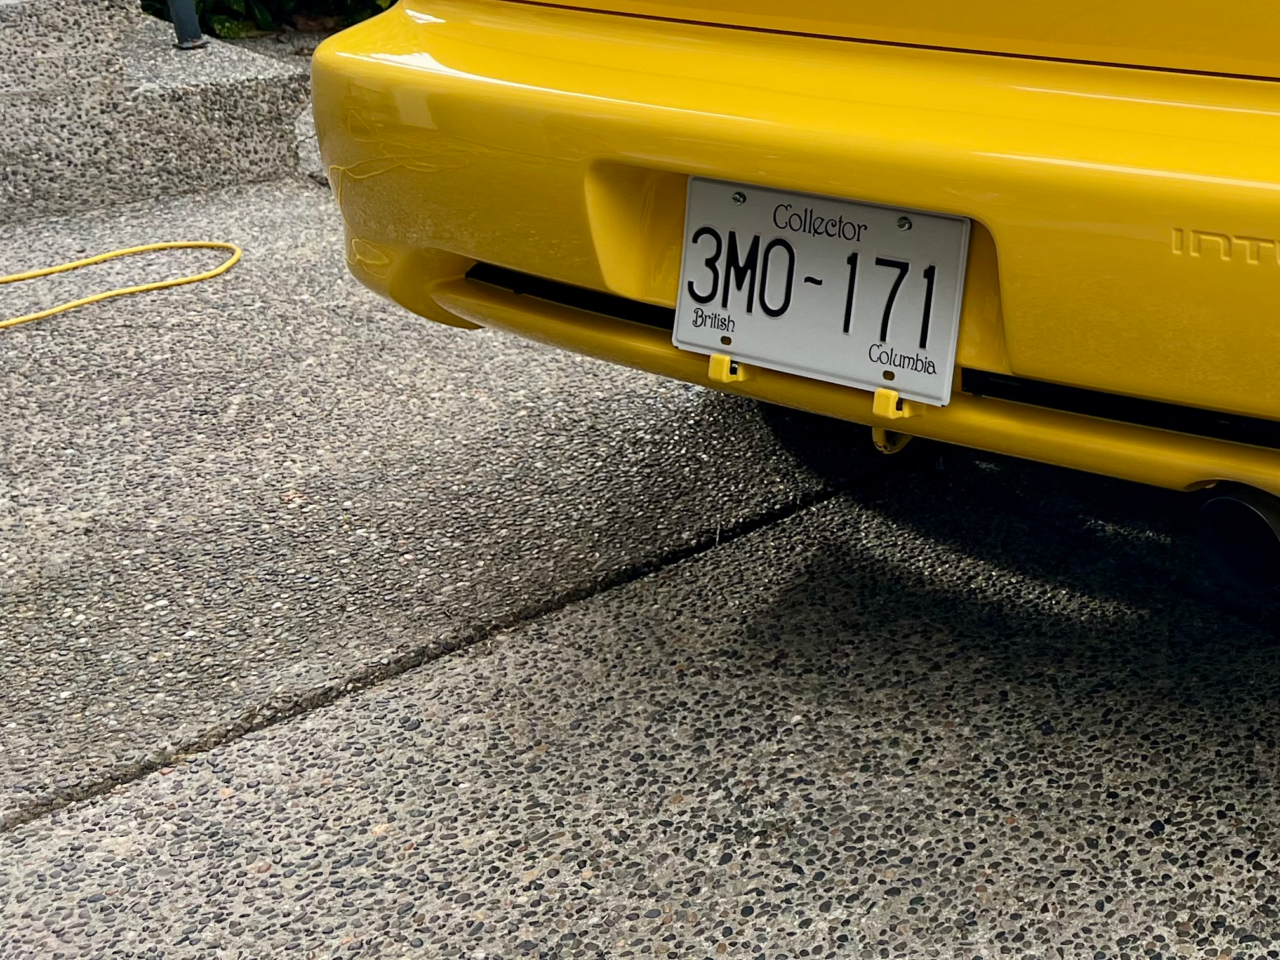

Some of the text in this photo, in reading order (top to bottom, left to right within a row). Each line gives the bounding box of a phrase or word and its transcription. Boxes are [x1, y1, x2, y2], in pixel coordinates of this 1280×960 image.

[772, 203, 867, 242] Collector
[691, 307, 736, 332] British
[868, 343, 938, 375] Columbia
